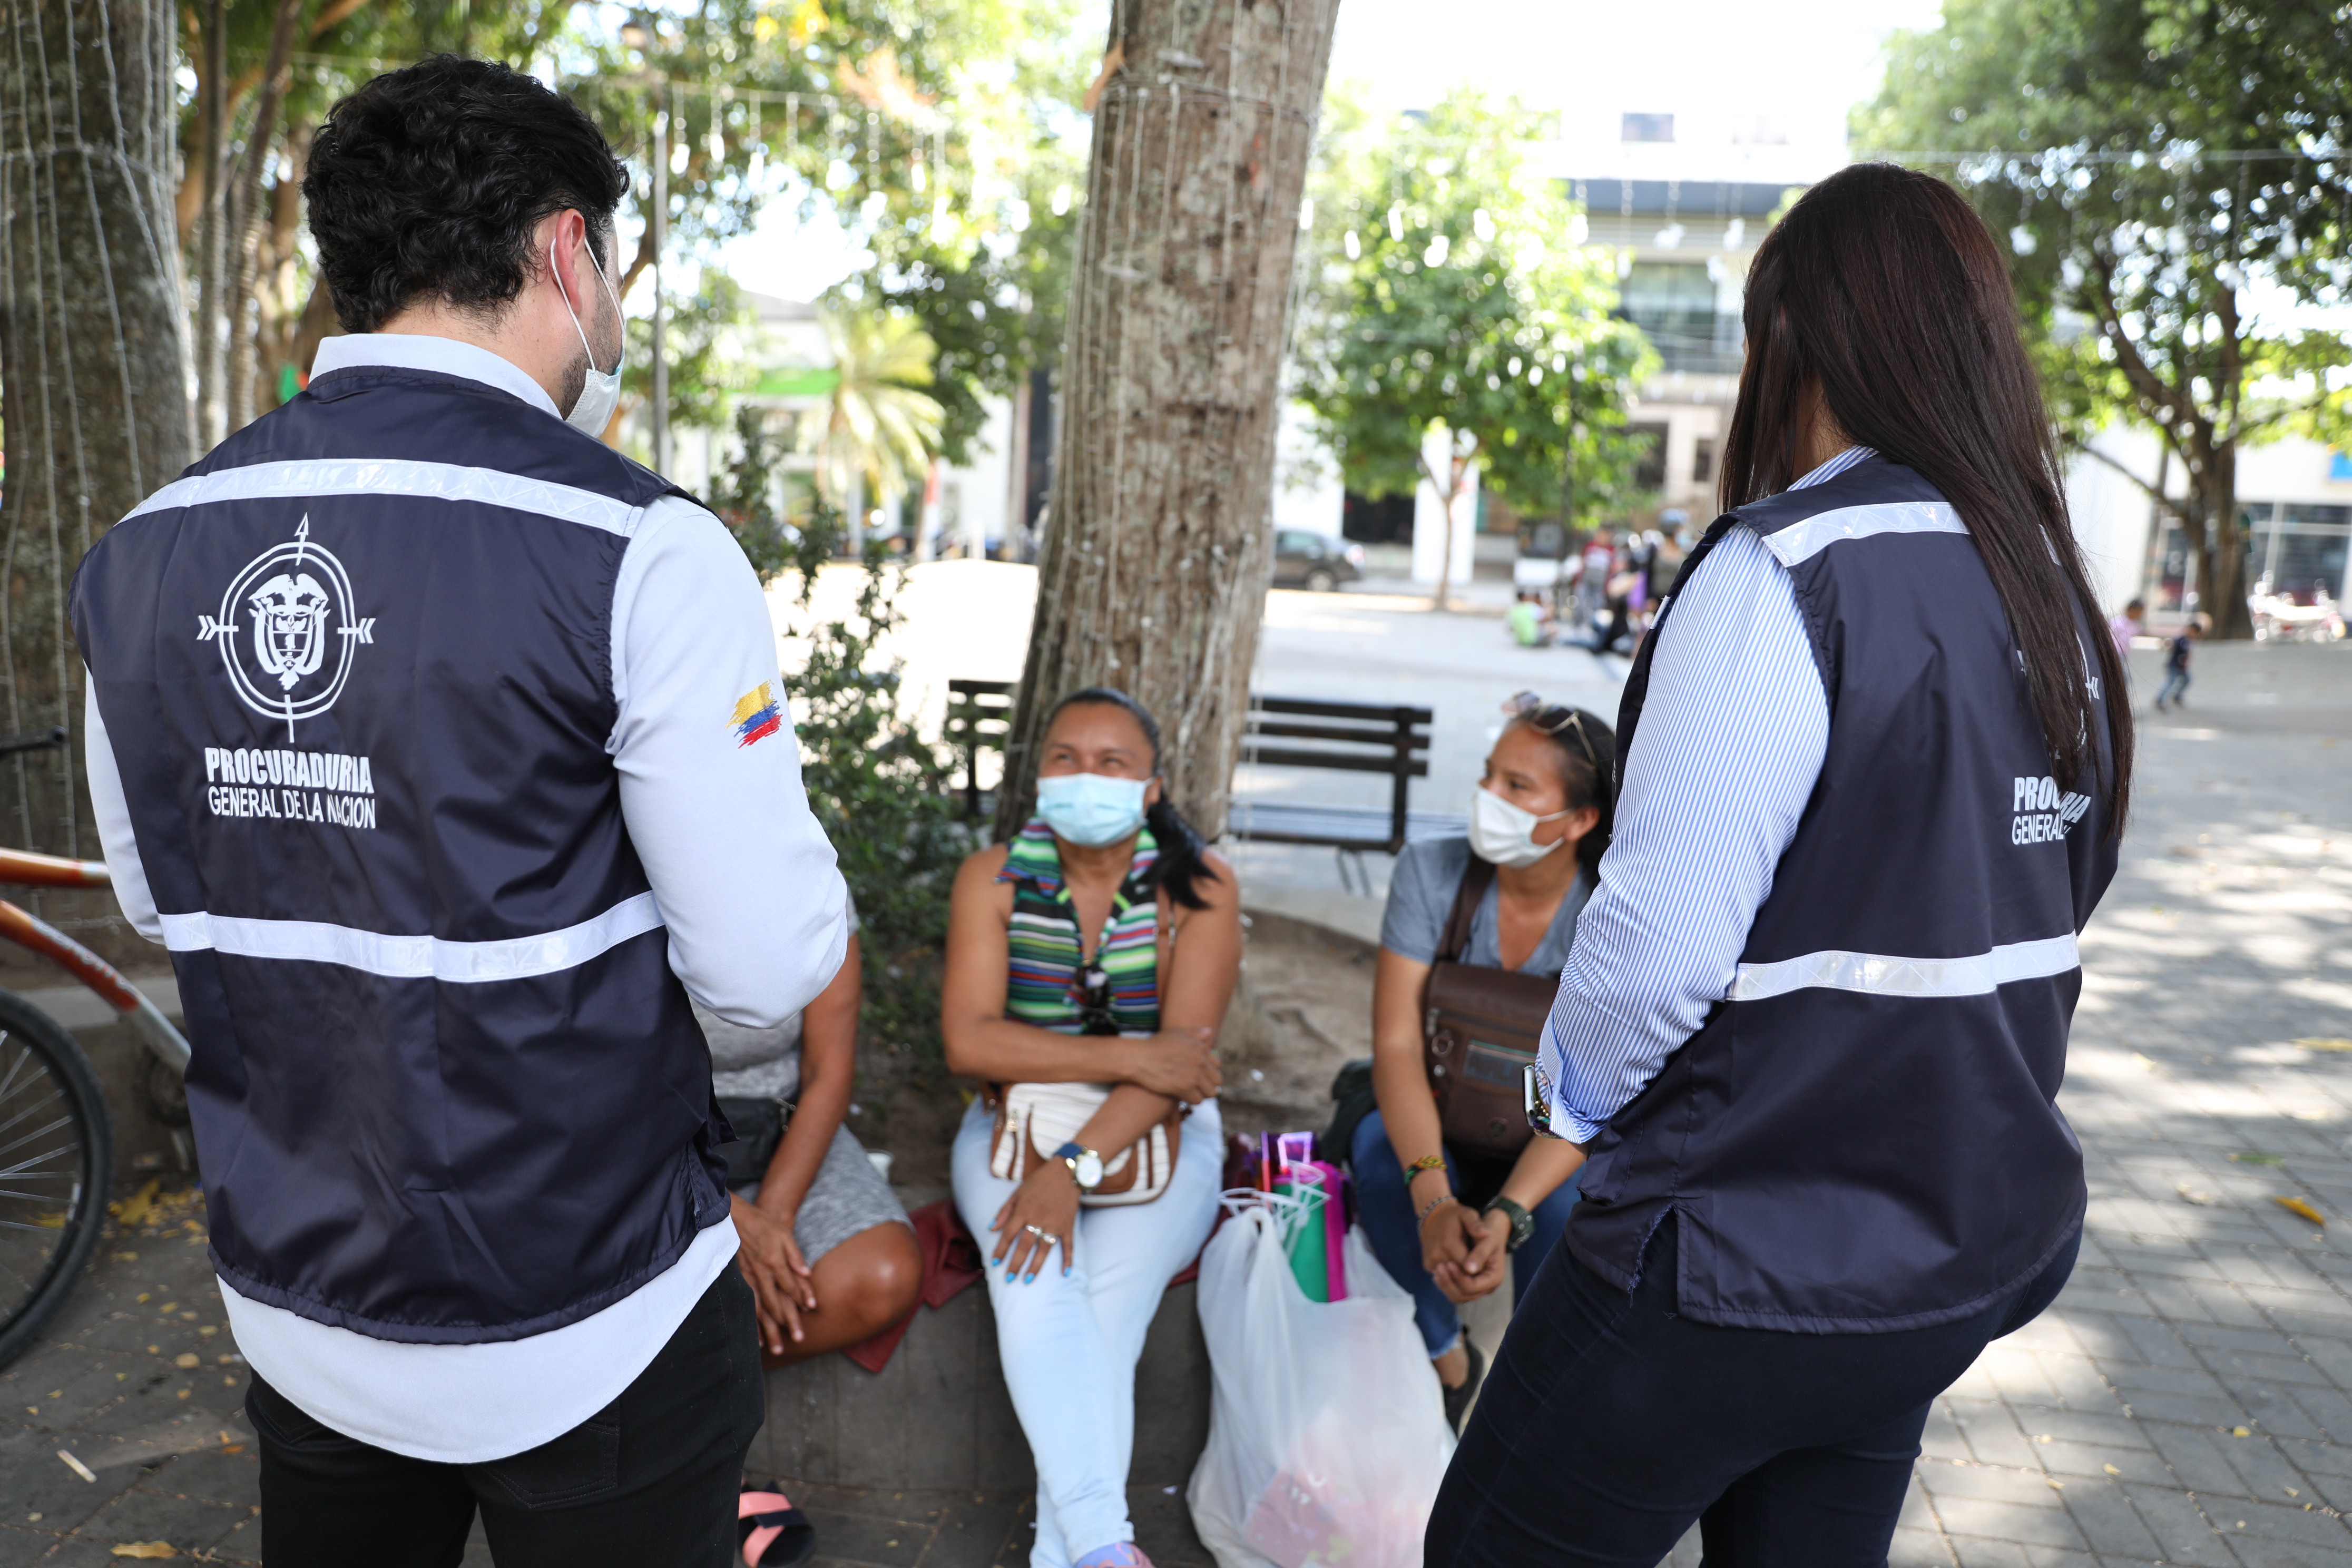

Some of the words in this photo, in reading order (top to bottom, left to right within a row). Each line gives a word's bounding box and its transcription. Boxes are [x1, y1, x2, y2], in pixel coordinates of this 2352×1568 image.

[204, 747, 375, 793] PROCURADURIA
[208, 786, 281, 818] GENERAL
[282, 789, 304, 819] DE
[303, 792, 324, 822] LA
[327, 793, 376, 829] NACION
[2012, 813, 2064, 845] GENERAL
